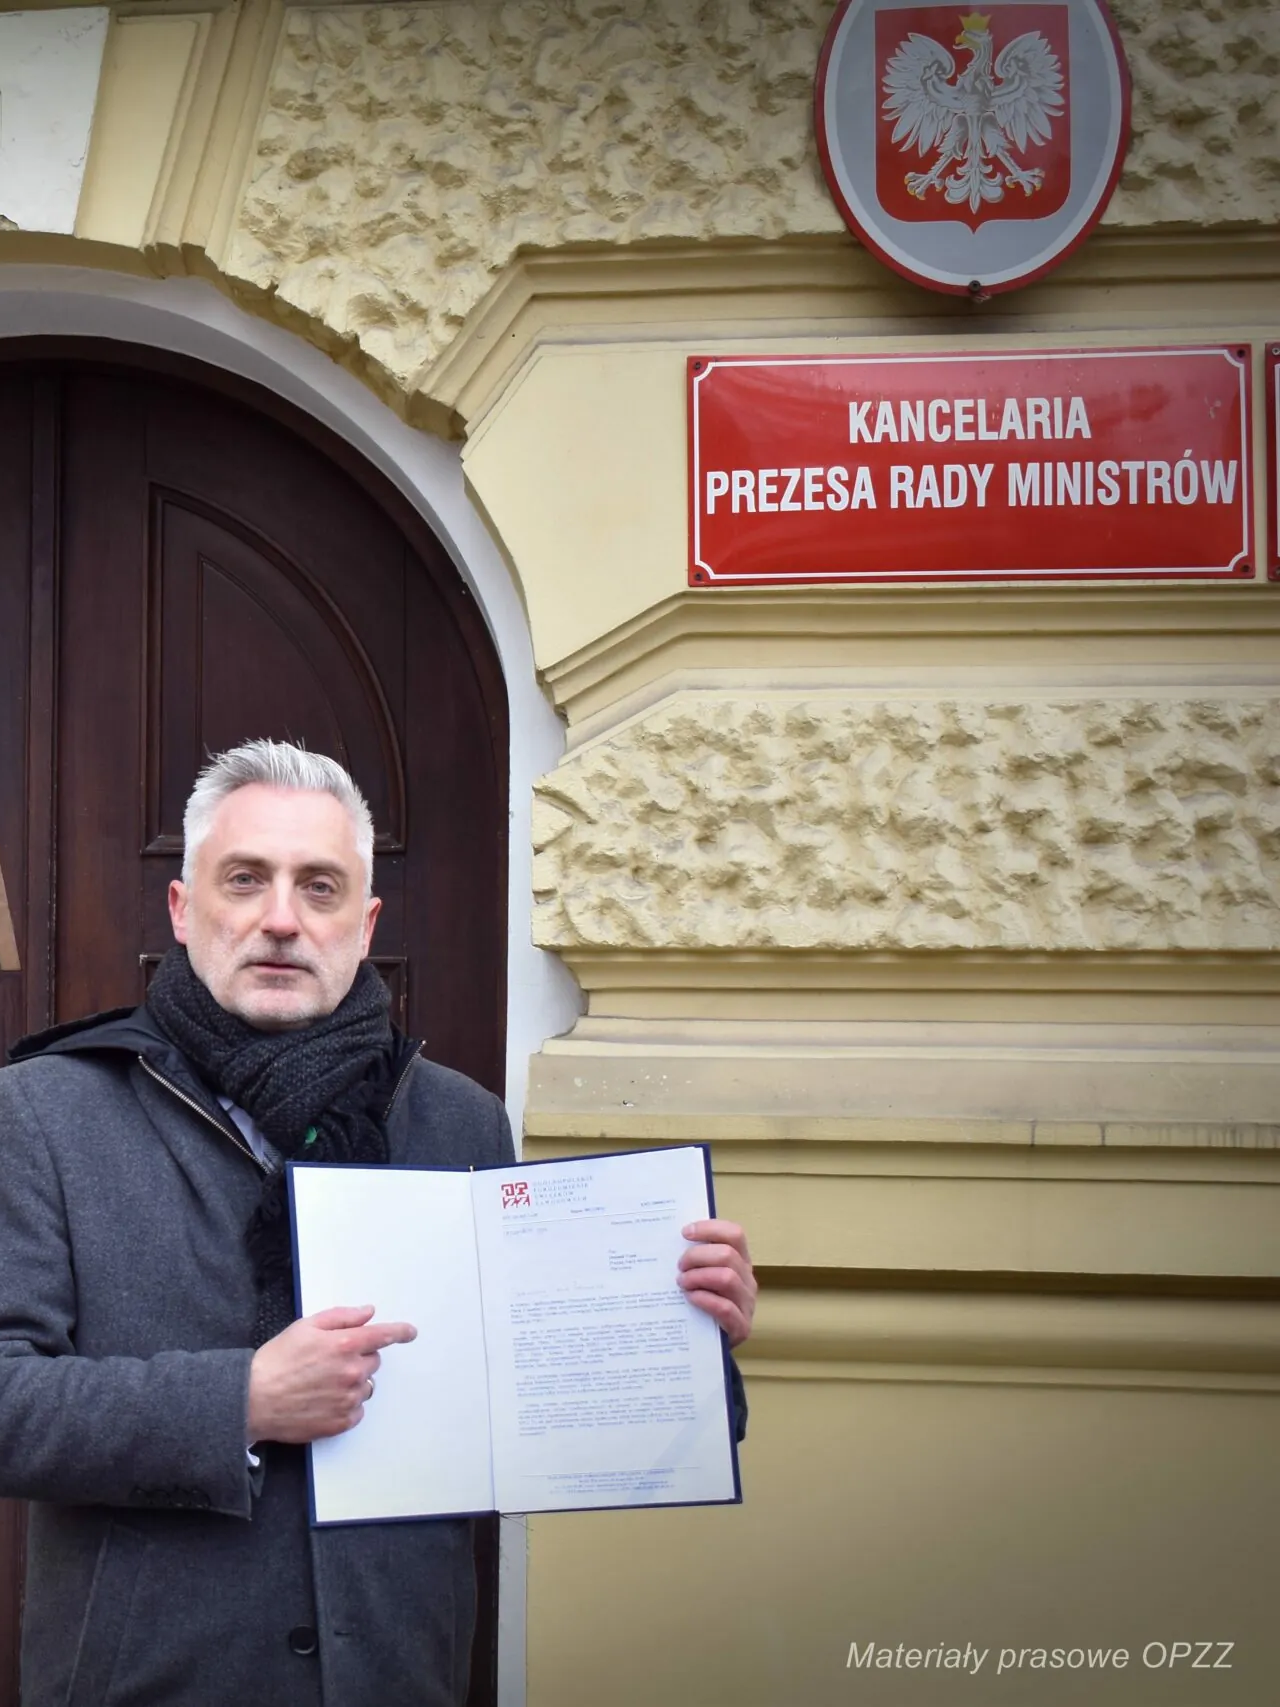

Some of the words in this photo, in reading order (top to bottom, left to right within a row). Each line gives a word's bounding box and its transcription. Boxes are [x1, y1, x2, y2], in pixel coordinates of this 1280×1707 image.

[848, 396, 1092, 444] KANCELARIA
[706, 465, 877, 515] PREZESA
[890, 463, 995, 509] RADY
[1008, 448, 1238, 507] MINISTRÓW
